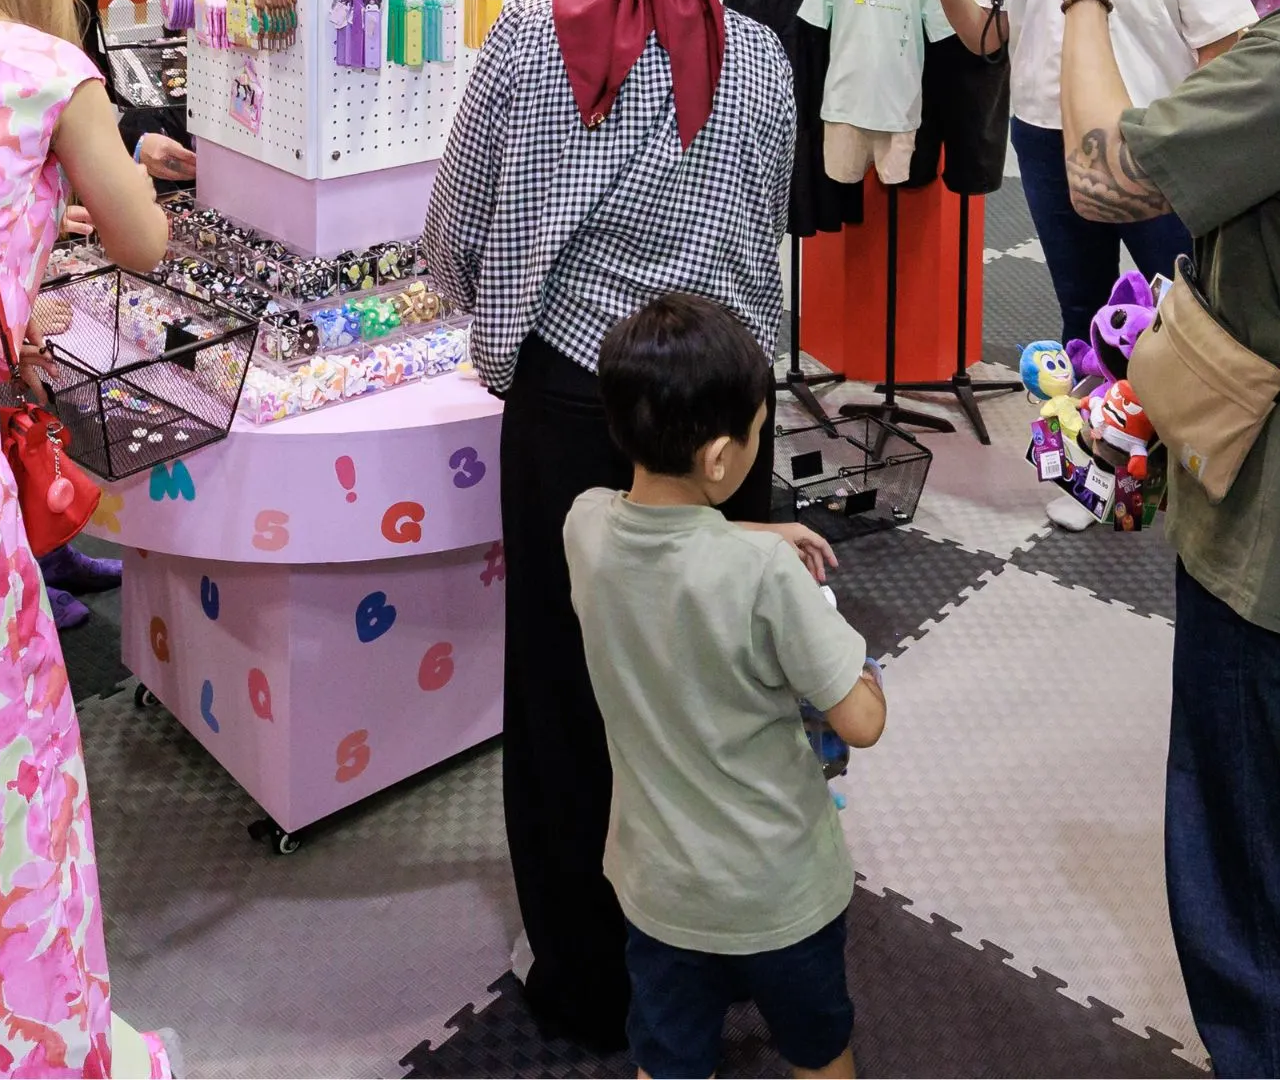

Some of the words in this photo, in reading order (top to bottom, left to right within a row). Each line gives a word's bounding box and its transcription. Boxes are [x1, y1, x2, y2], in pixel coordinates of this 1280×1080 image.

[149, 460, 196, 502] M
[449, 446, 487, 489] 3
[380, 501, 426, 544] G
[200, 575, 220, 621] U
[355, 591, 397, 643] B
[200, 679, 220, 734] L
[247, 667, 274, 724] Q
